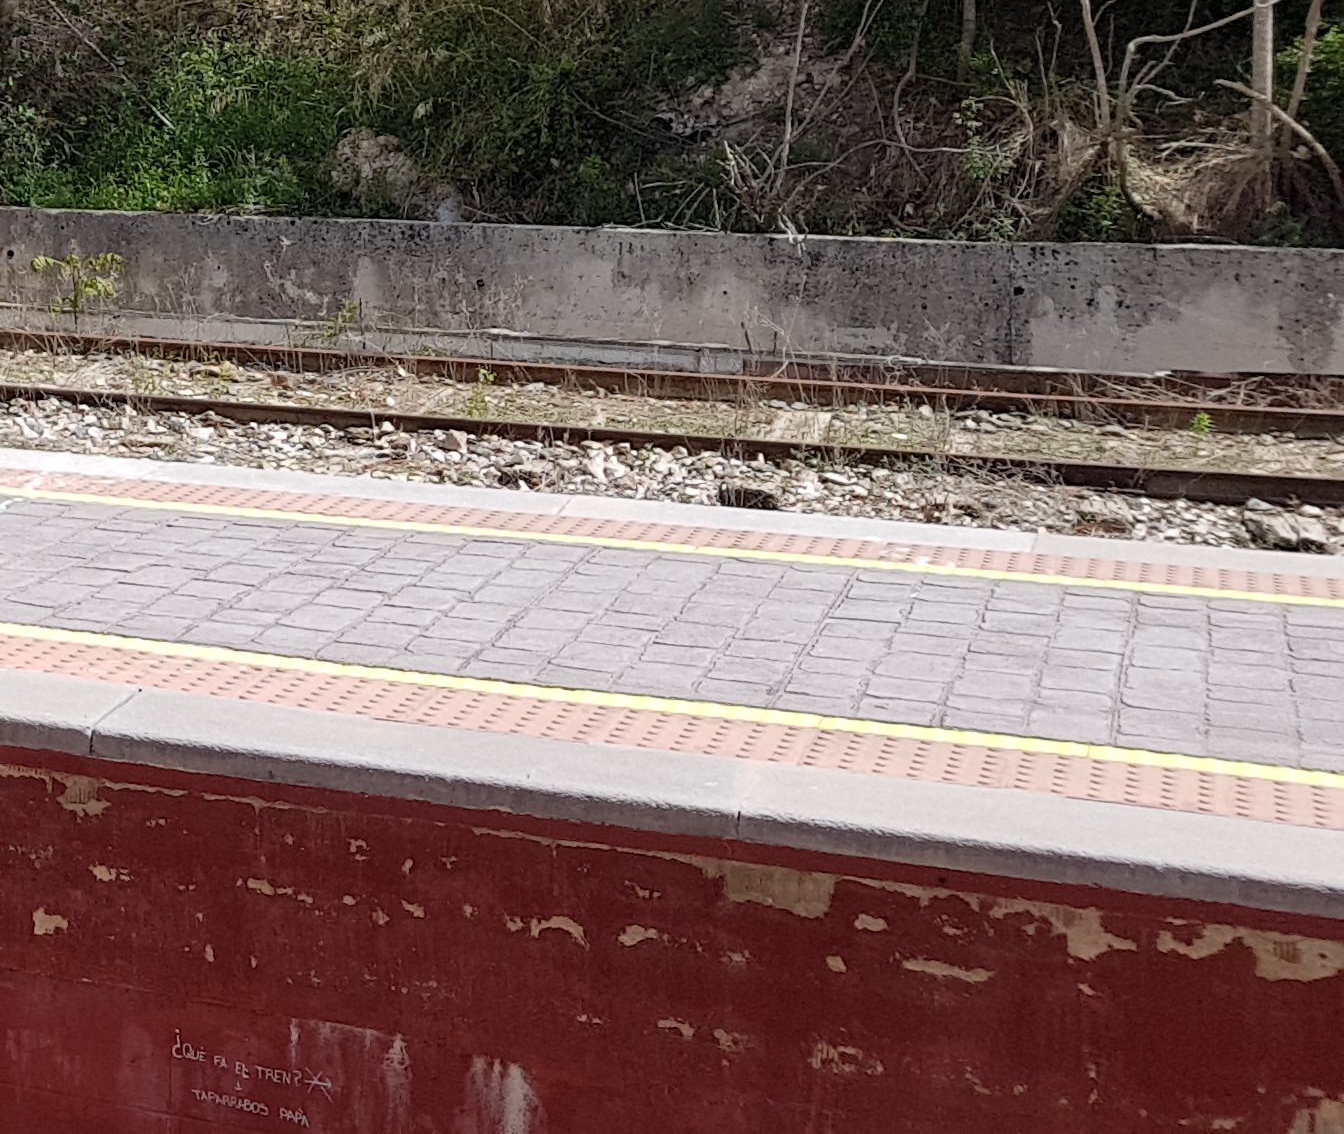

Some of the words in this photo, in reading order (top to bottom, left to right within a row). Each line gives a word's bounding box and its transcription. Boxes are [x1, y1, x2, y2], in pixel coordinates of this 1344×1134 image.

[214, 1055, 227, 1068] FA
[255, 1065, 302, 1086] TREN?
[191, 1089, 268, 1116] TAPARRABOS
